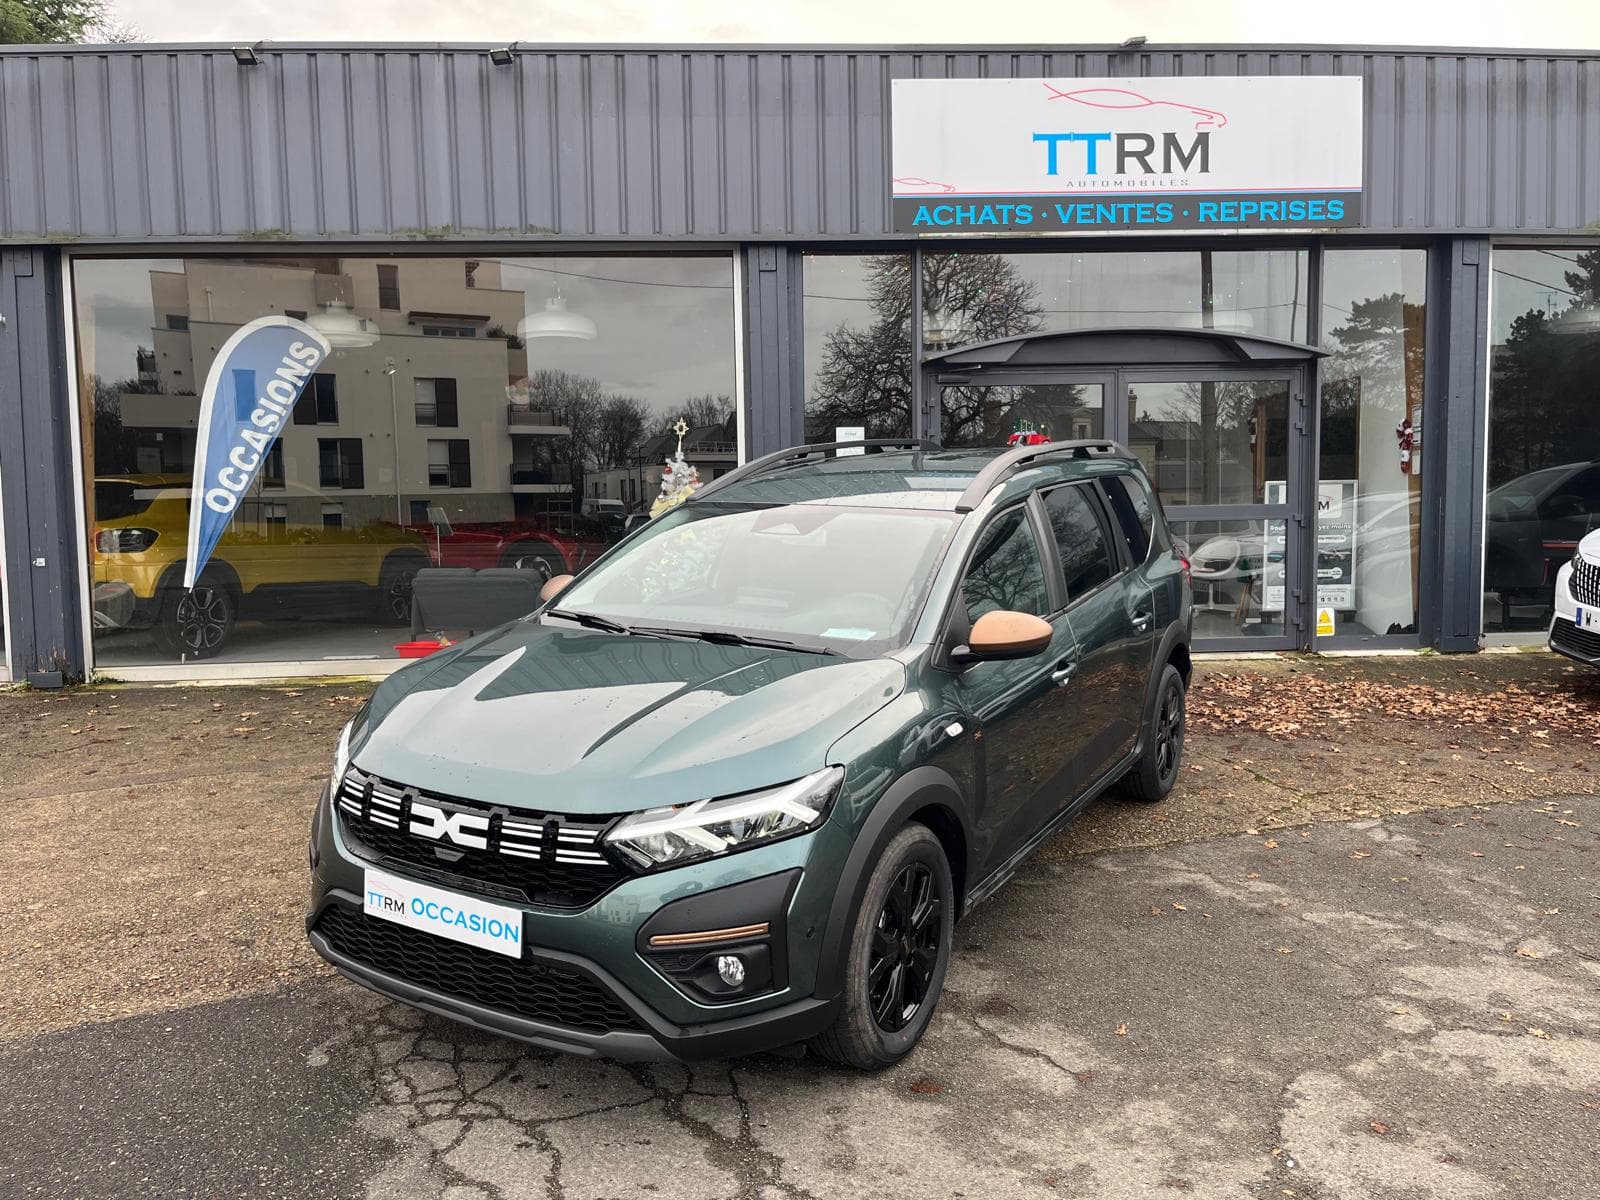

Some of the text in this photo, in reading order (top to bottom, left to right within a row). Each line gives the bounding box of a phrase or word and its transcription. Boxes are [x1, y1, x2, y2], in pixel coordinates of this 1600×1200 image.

[1032, 131, 1211, 175] TTRM
[1066, 179, 1190, 188] AUTOMOBILES
[912, 199, 1345, 227] ACHATS VENTES REPRISES
[205, 341, 321, 514] OCCASIONS
[367, 891, 519, 943] TTRM OCCASION
